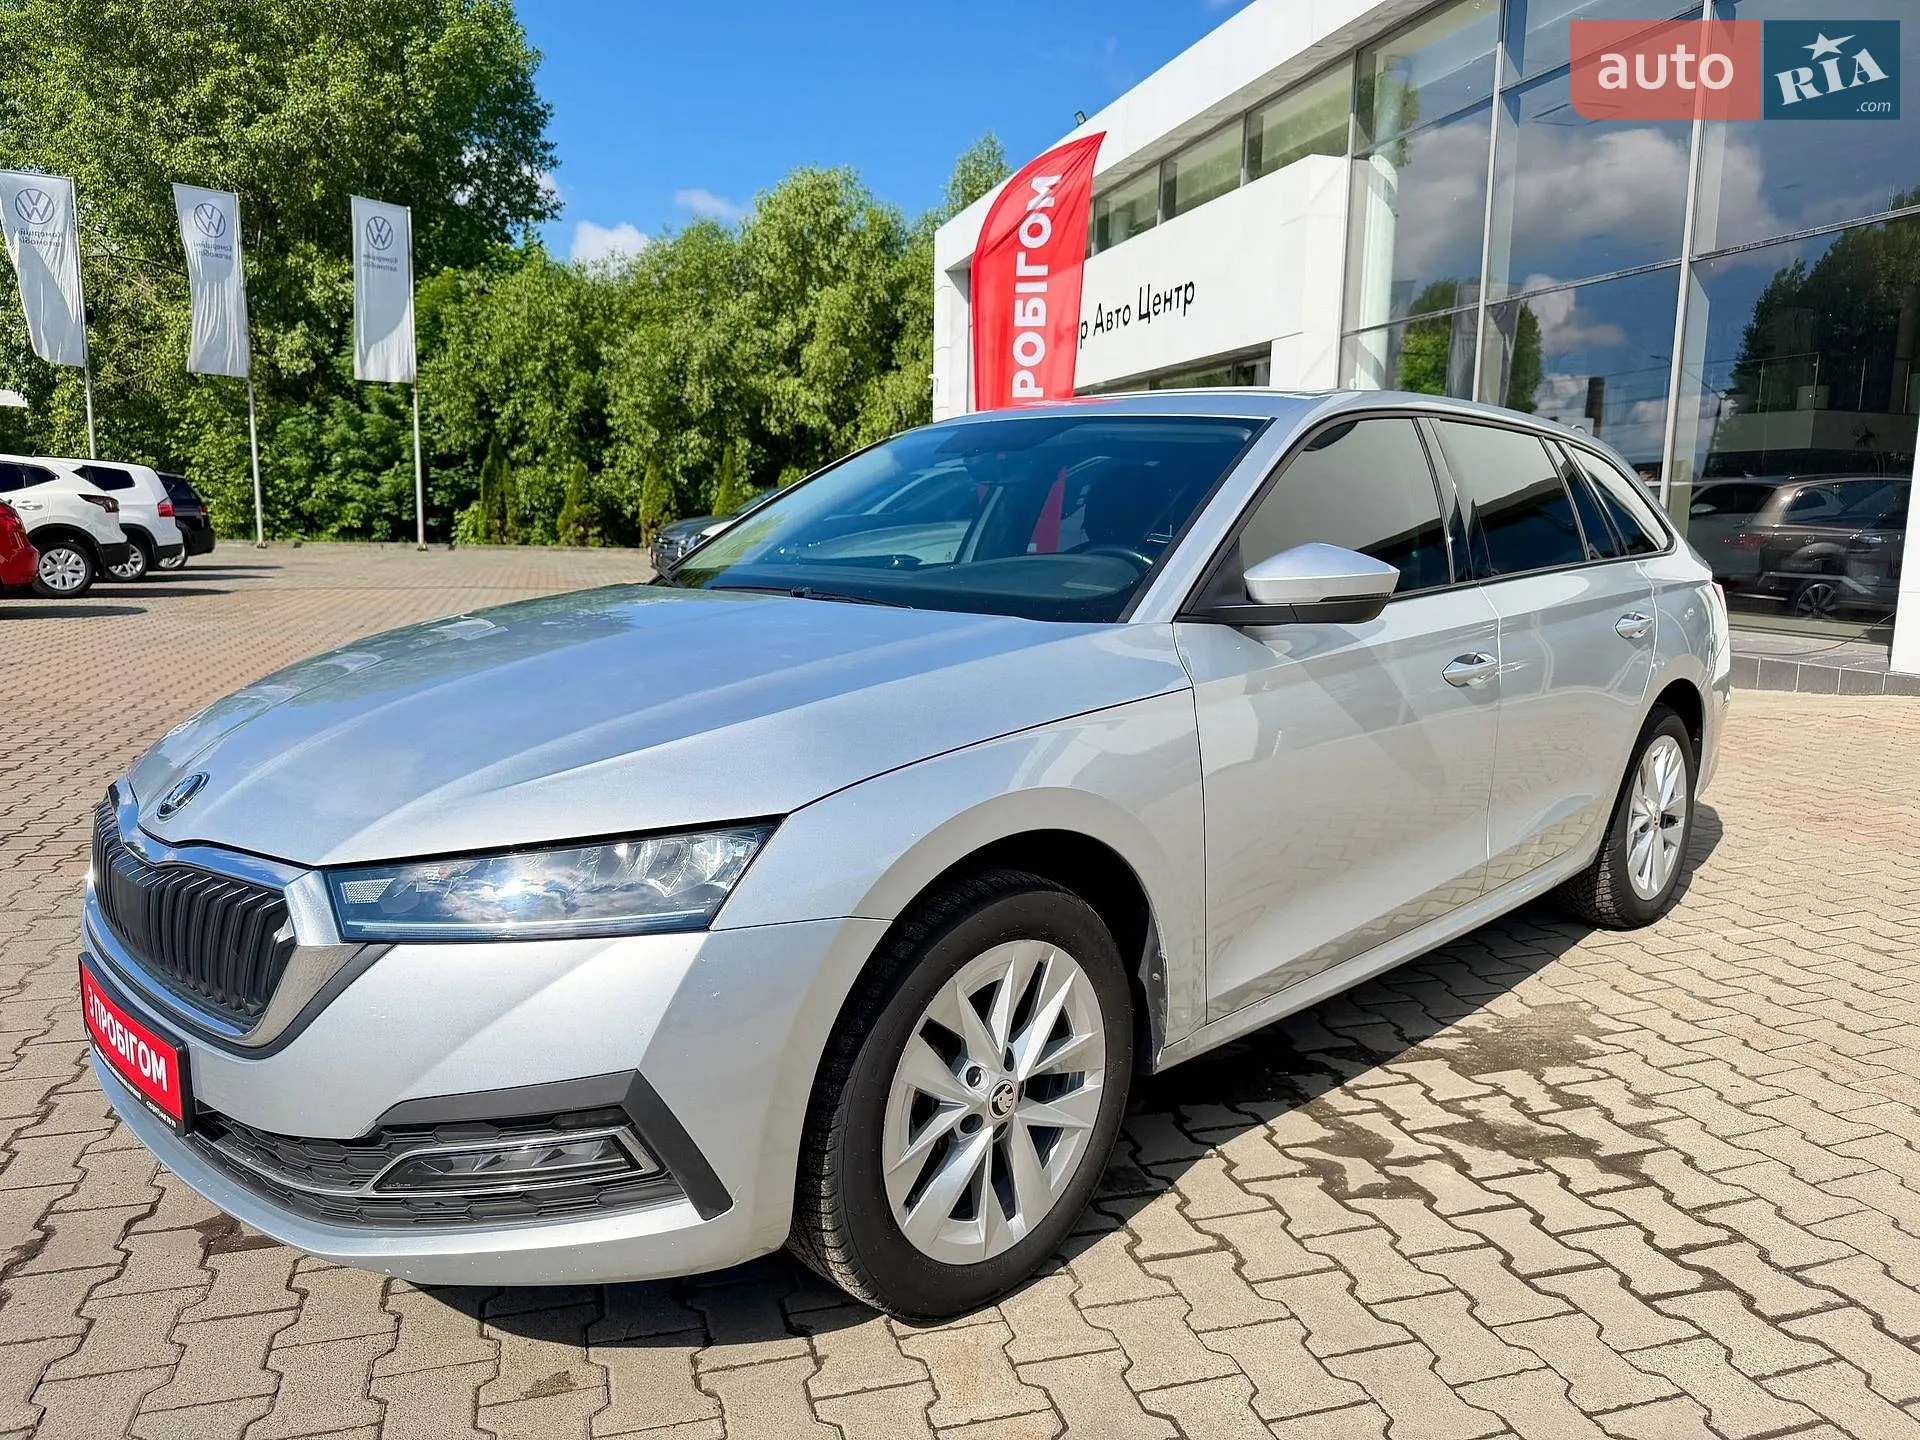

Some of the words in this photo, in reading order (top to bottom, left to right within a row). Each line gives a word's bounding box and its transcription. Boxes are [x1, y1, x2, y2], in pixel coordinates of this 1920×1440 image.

[1093, 303, 1131, 336] Авто
[1138, 281, 1195, 324] Центр
[87, 984, 96, 1018] З
[94, 1001, 168, 1093] ПРОБІГОМ
